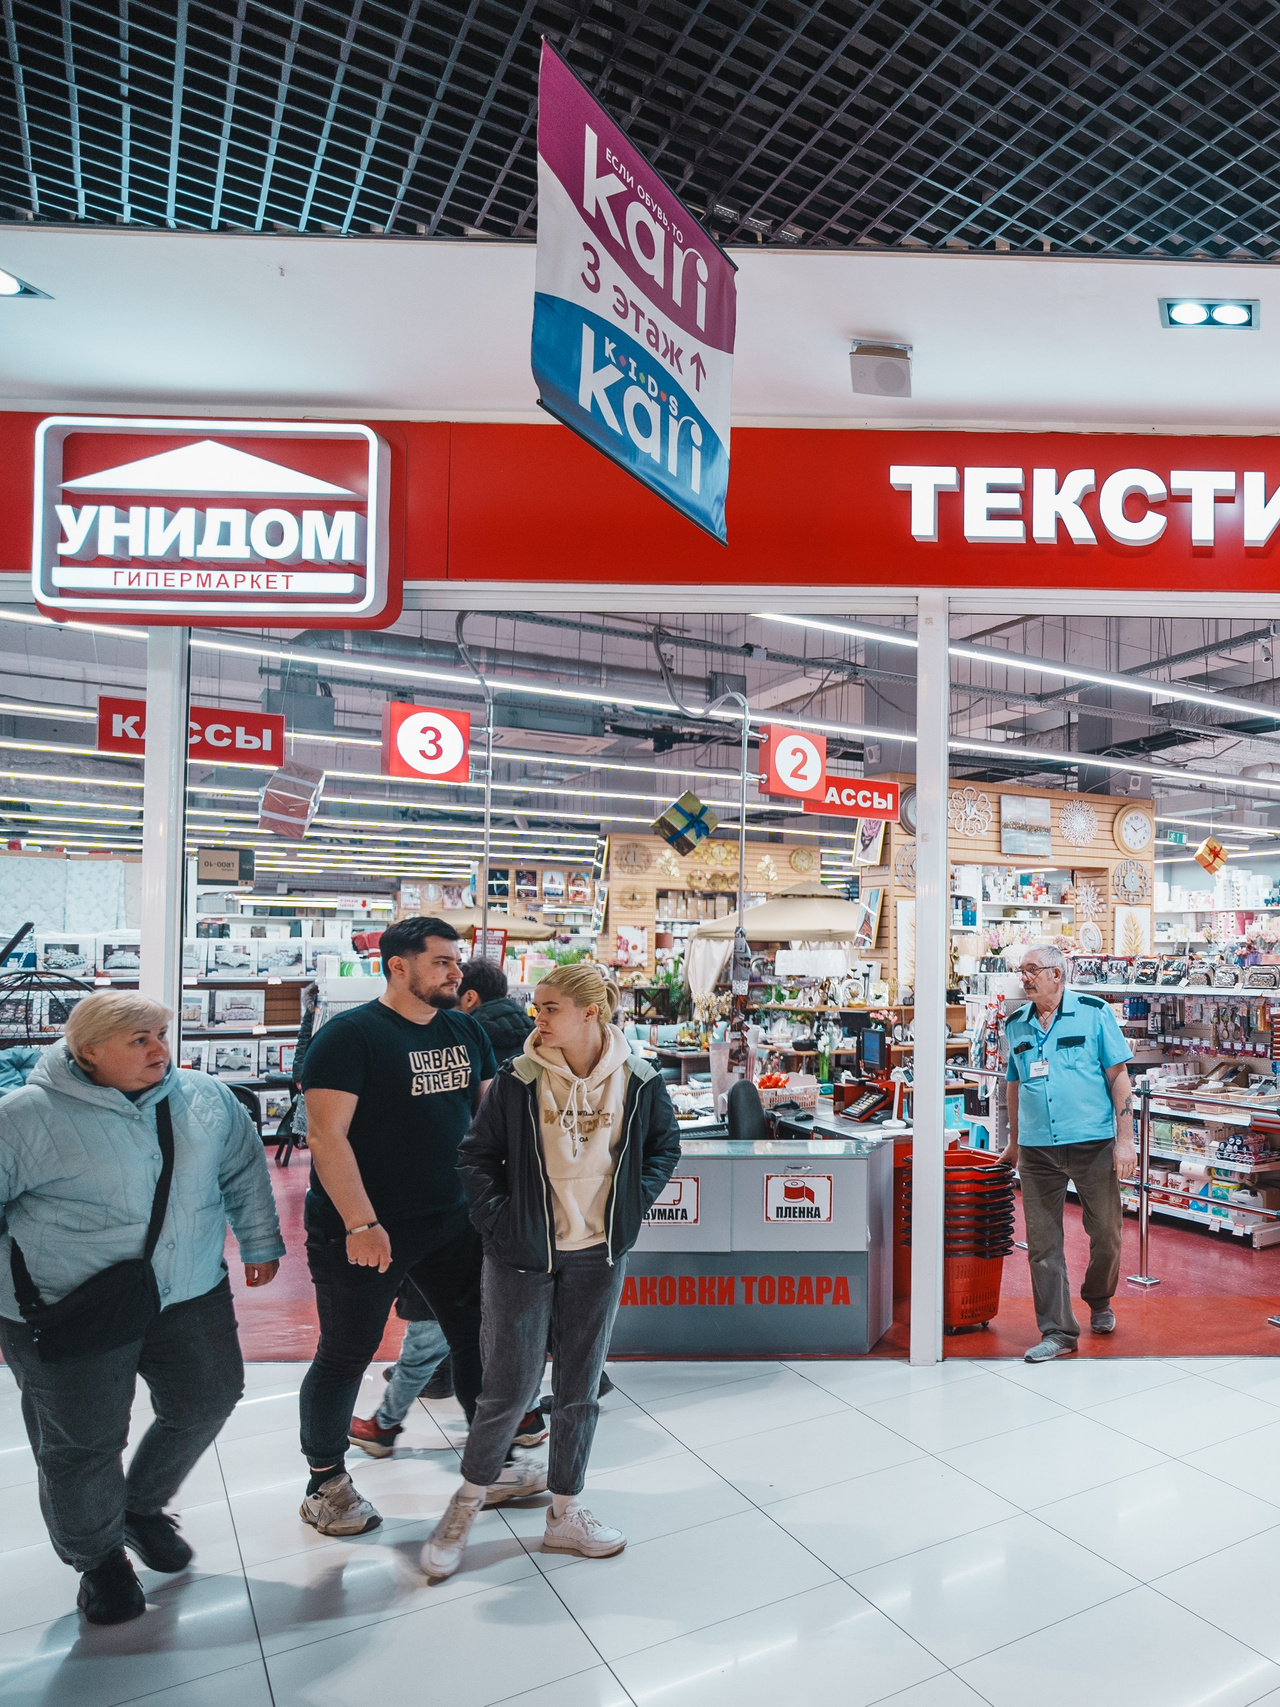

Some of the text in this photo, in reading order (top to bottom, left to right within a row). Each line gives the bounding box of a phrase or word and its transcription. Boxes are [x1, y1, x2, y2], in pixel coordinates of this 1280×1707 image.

[605, 147, 635, 189] ЕСЛИ
[670, 221, 686, 246] ТО
[583, 123, 710, 333] kari
[580, 241, 686, 375] 3 этаж
[578, 322, 703, 495] kari
[54, 504, 358, 561] УНИДОМ
[112, 569, 295, 591] ГИПЕРМАРКЕТ
[417, 726, 444, 761] 3
[789, 747, 808, 781] 2
[822, 786, 893, 811] АССЫ
[408, 1045, 471, 1074] URBAN
[411, 1067, 472, 1096] STREET
[775, 1206, 822, 1220] ПЛЕНКА
[740, 1275, 851, 1306] ТОВАРА
